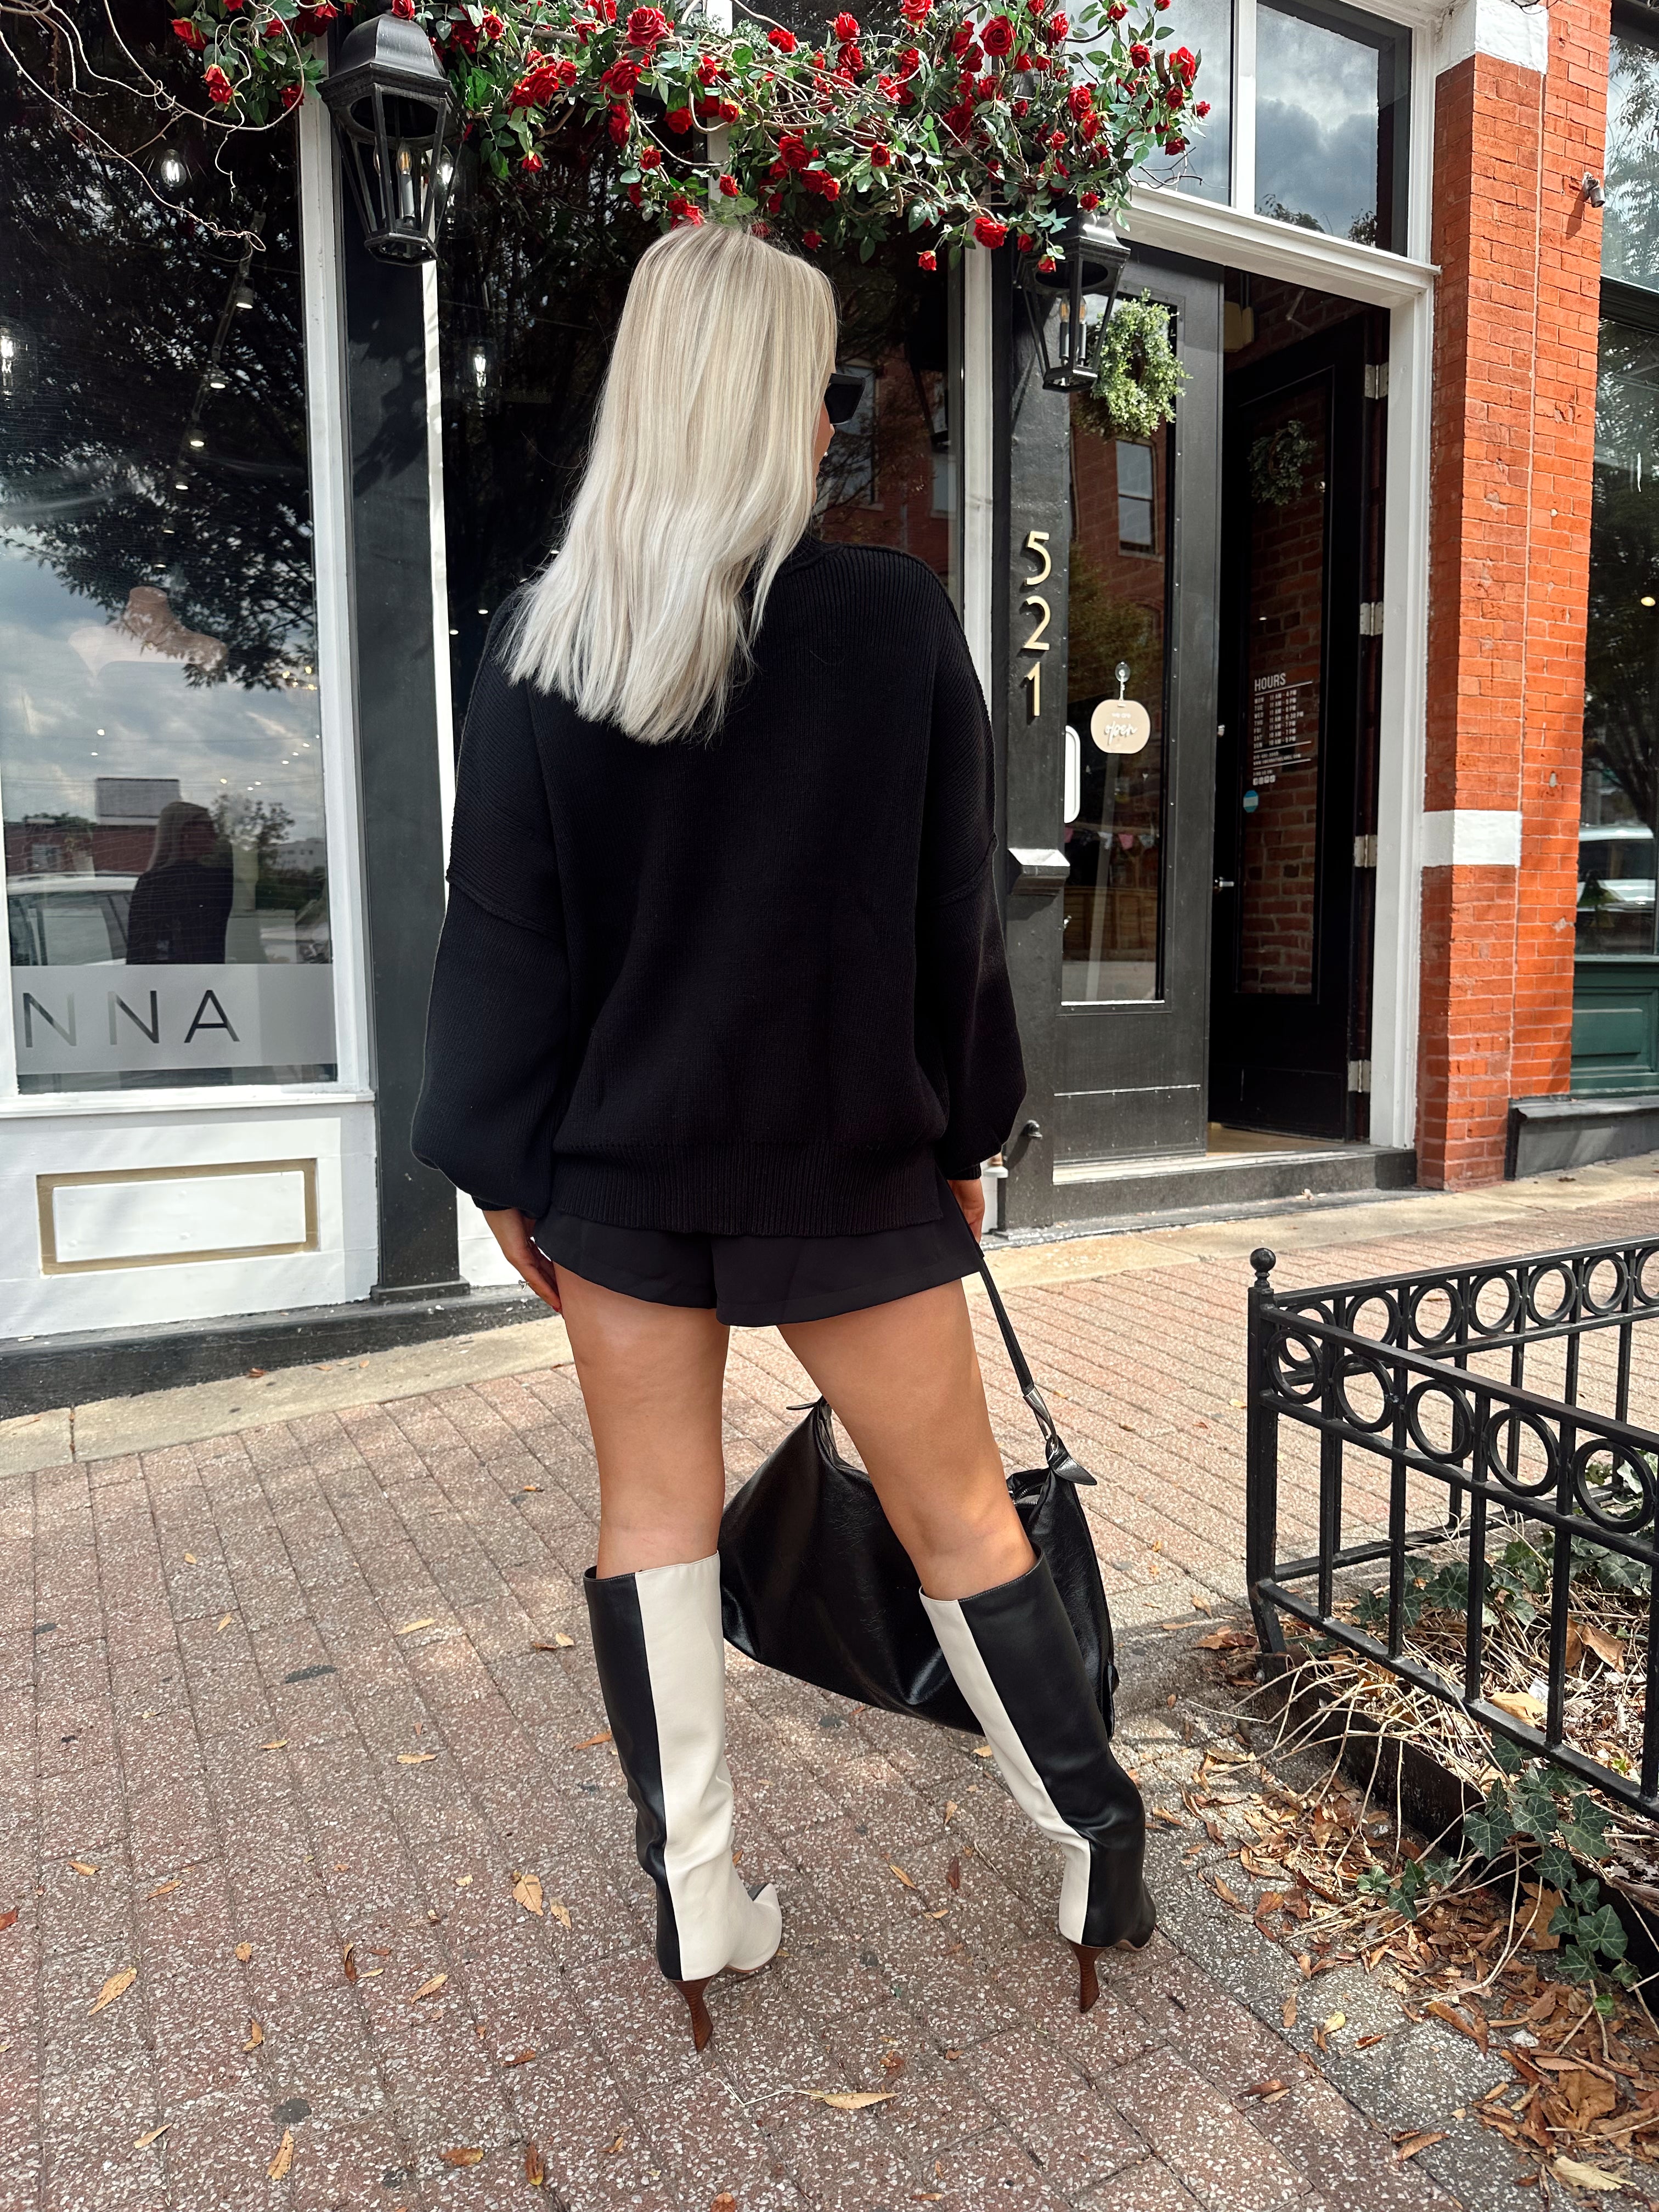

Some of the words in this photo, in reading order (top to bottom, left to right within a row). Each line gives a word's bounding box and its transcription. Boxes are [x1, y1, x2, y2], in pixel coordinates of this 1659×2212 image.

[1024, 531, 1051, 716] 521
[1254, 673, 1286, 692] HOURS
[1104, 720, 1138, 744] open
[22, 990, 240, 1047] NNA
